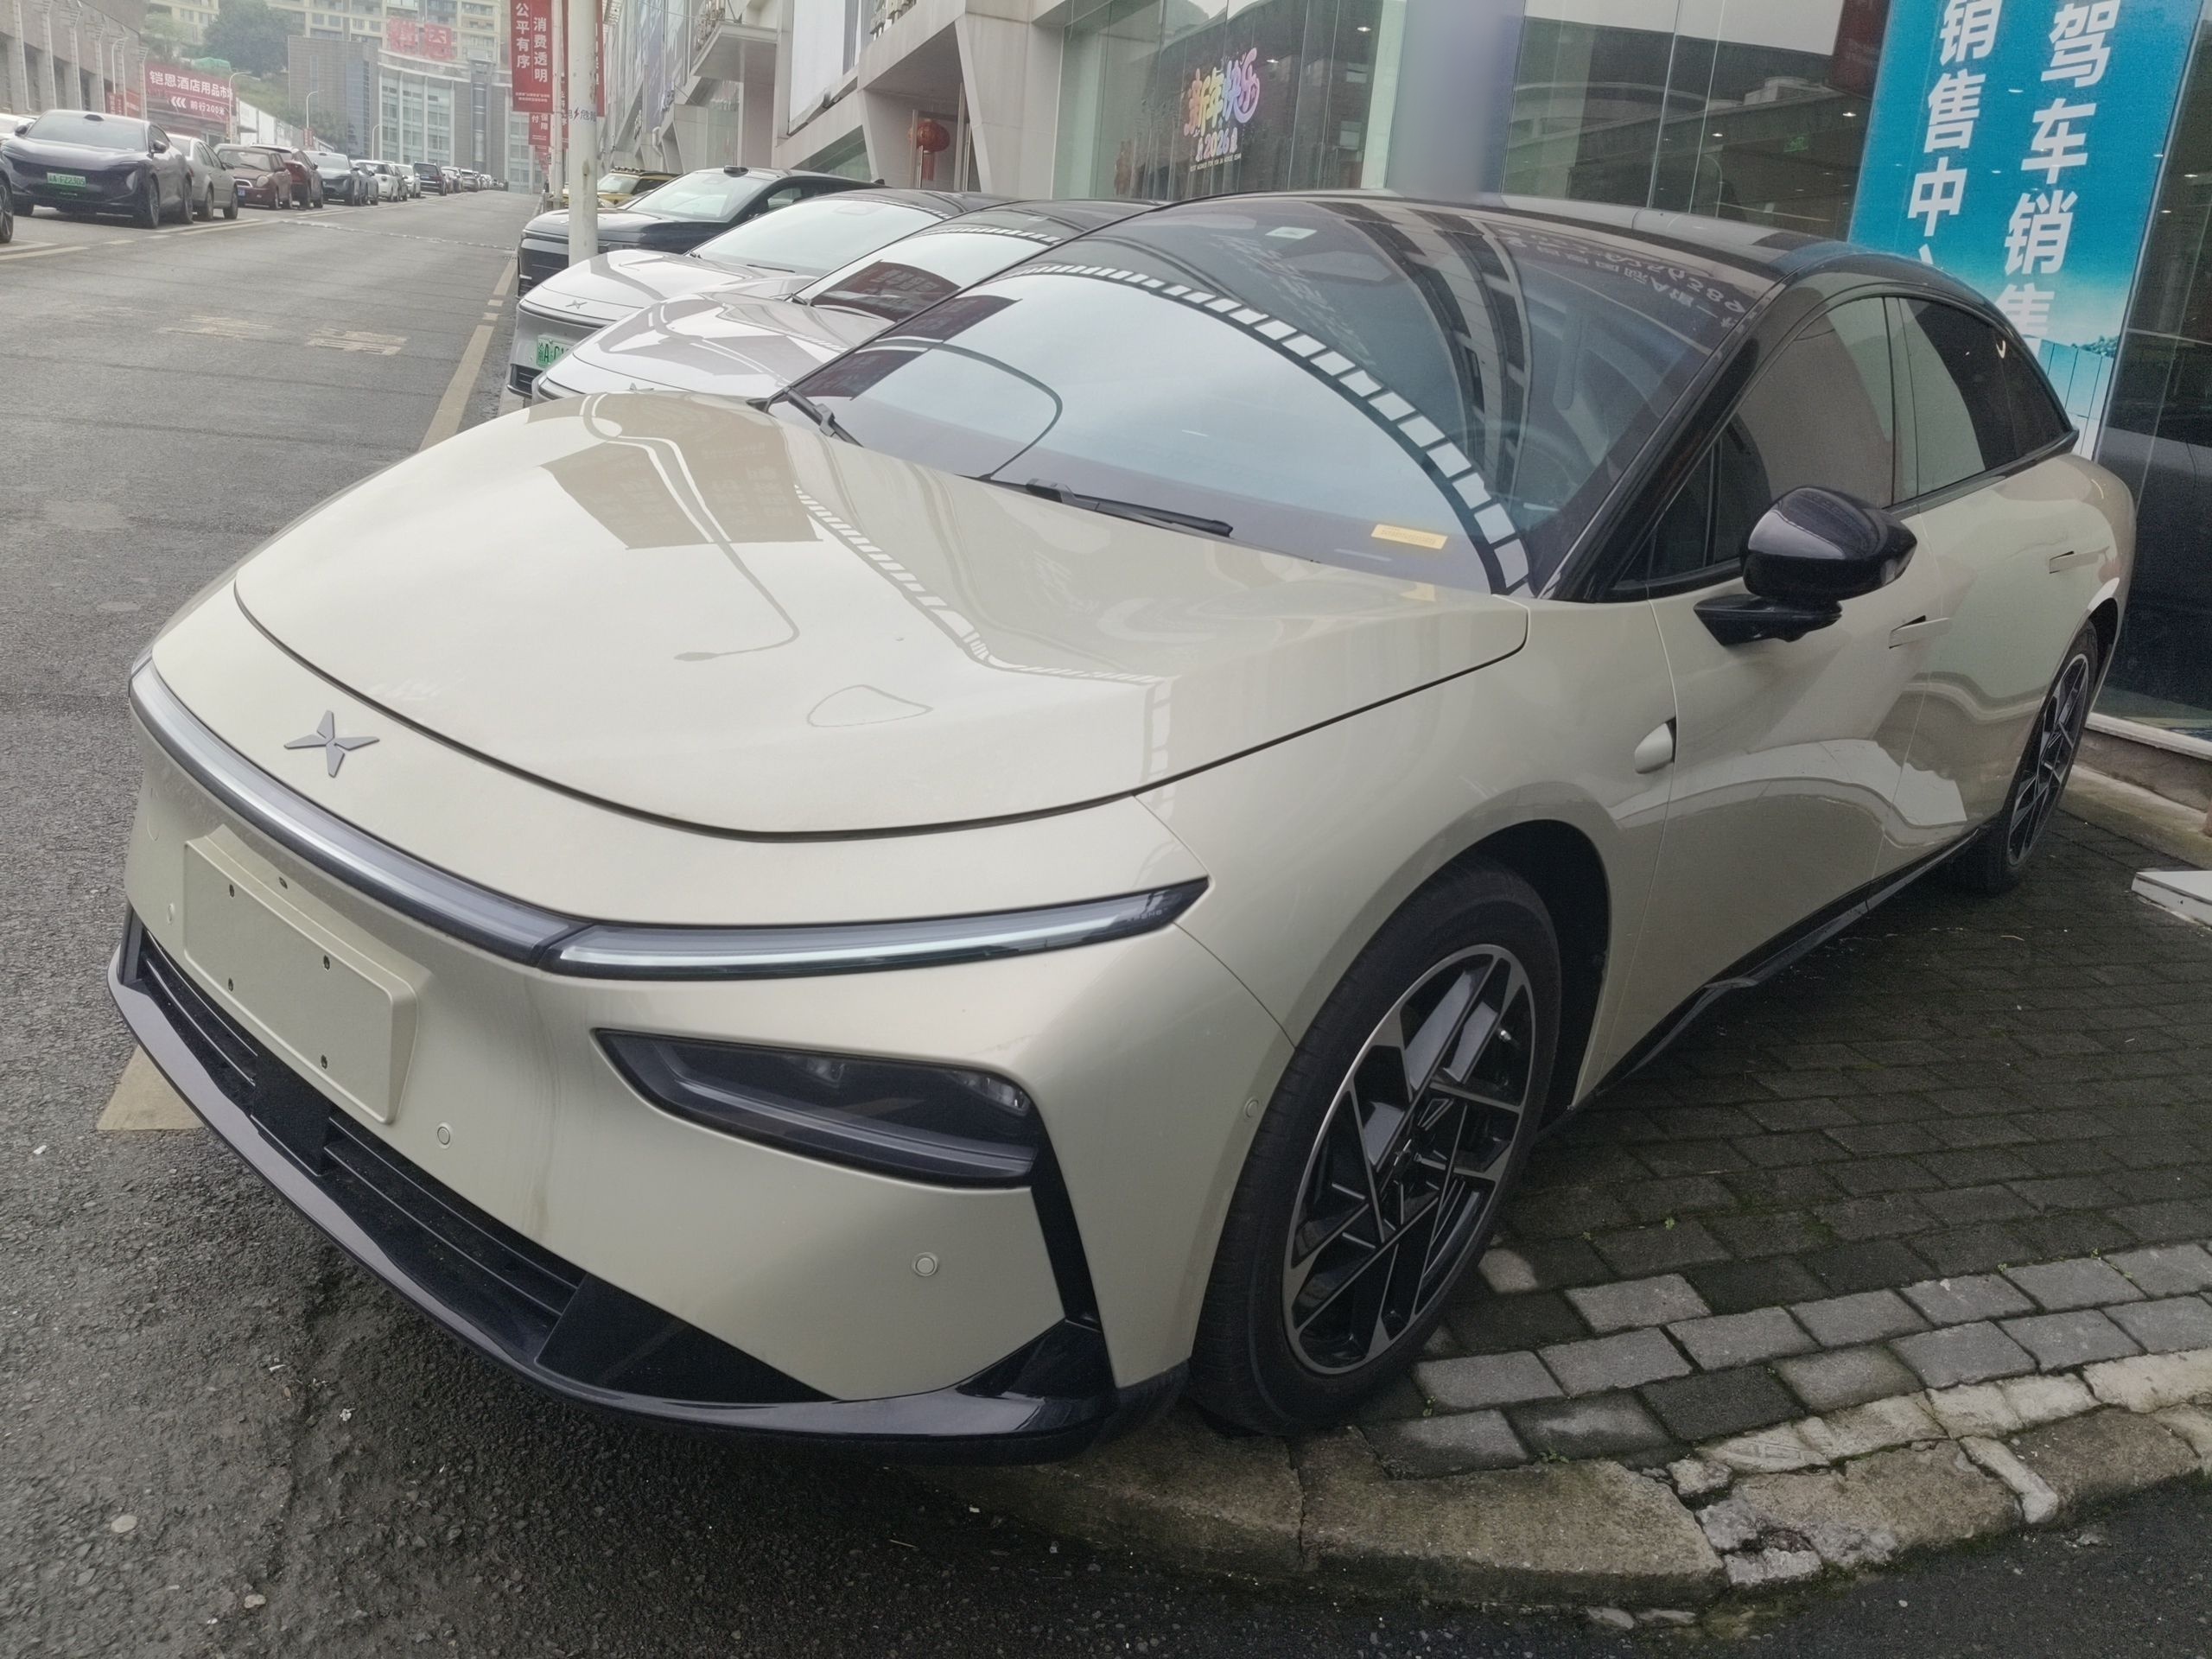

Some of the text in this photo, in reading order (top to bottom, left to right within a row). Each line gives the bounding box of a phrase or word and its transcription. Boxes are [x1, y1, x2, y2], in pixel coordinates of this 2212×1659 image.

[516, 3, 531, 68] 公平有序
[534, 16, 548, 83] 消费透明
[190, 100, 225, 116] 前行200米
[1184, 48, 1260, 138] 新年快乐
[1203, 129, 1230, 160] 2026
[1907, 0, 2003, 264] 销售中
